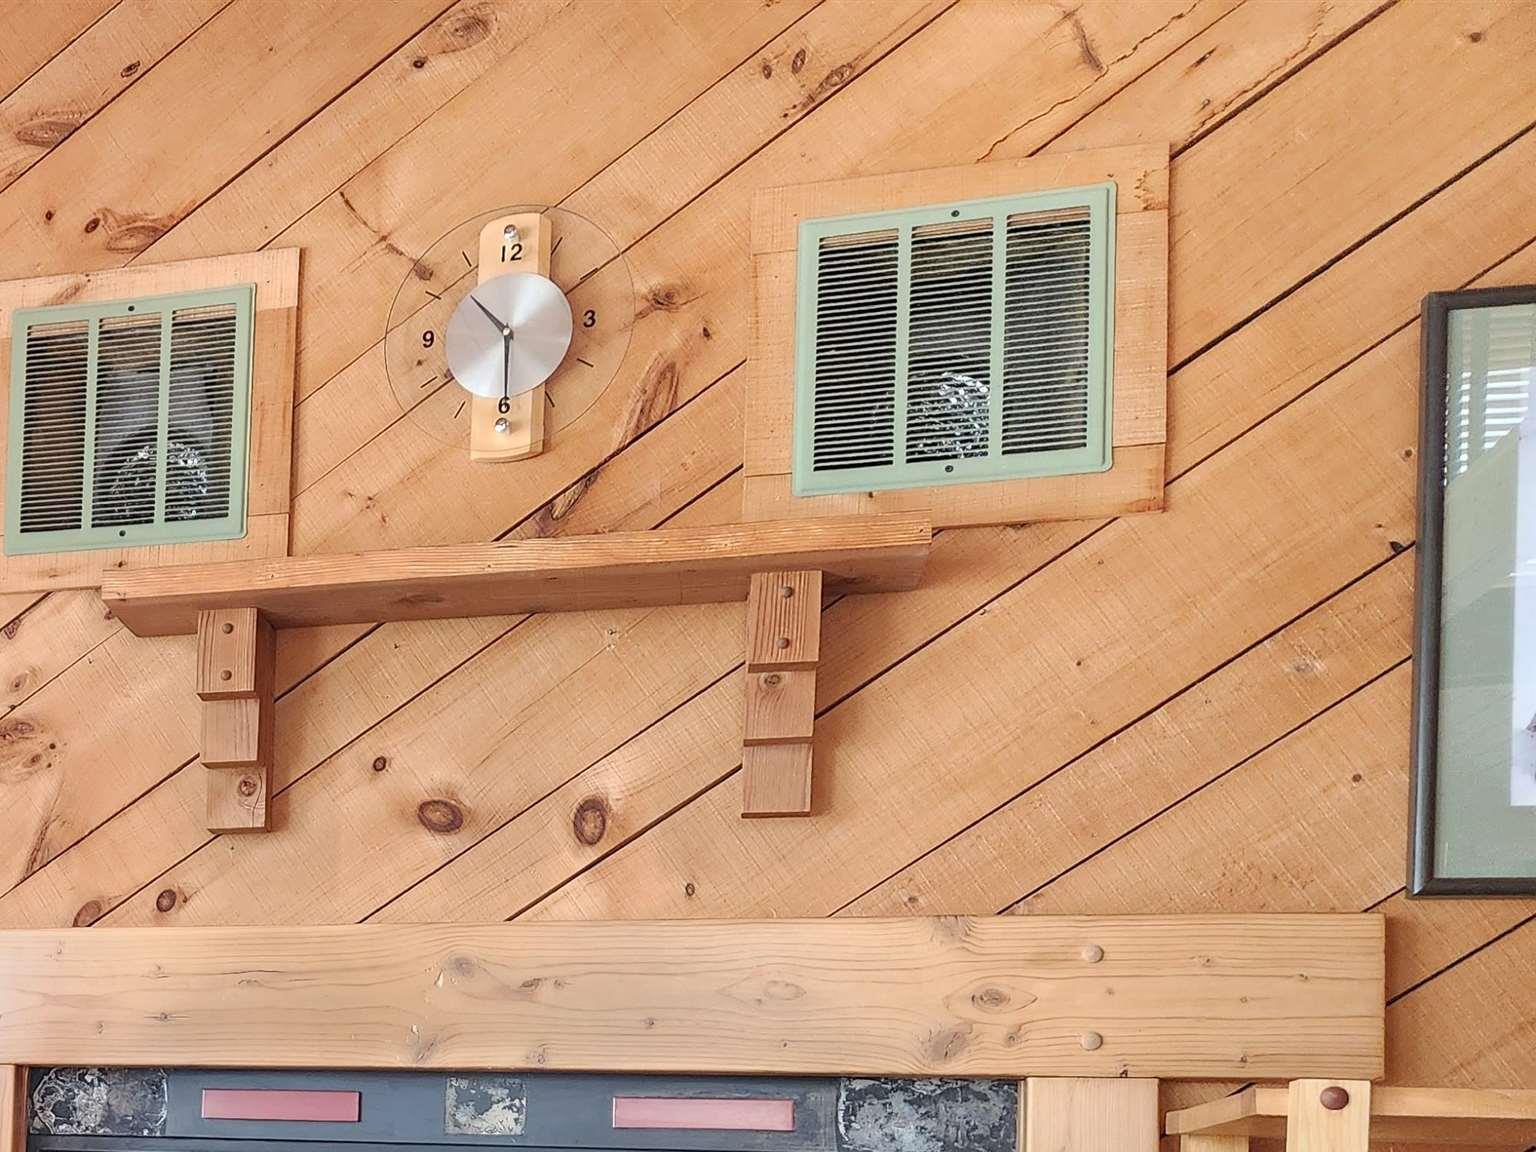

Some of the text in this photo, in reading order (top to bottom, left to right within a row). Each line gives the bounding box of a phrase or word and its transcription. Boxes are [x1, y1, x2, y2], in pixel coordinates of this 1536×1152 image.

[501, 244, 522, 262] 12
[583, 310, 596, 327] 3
[422, 331, 435, 347] 9
[498, 397, 510, 413] 6
